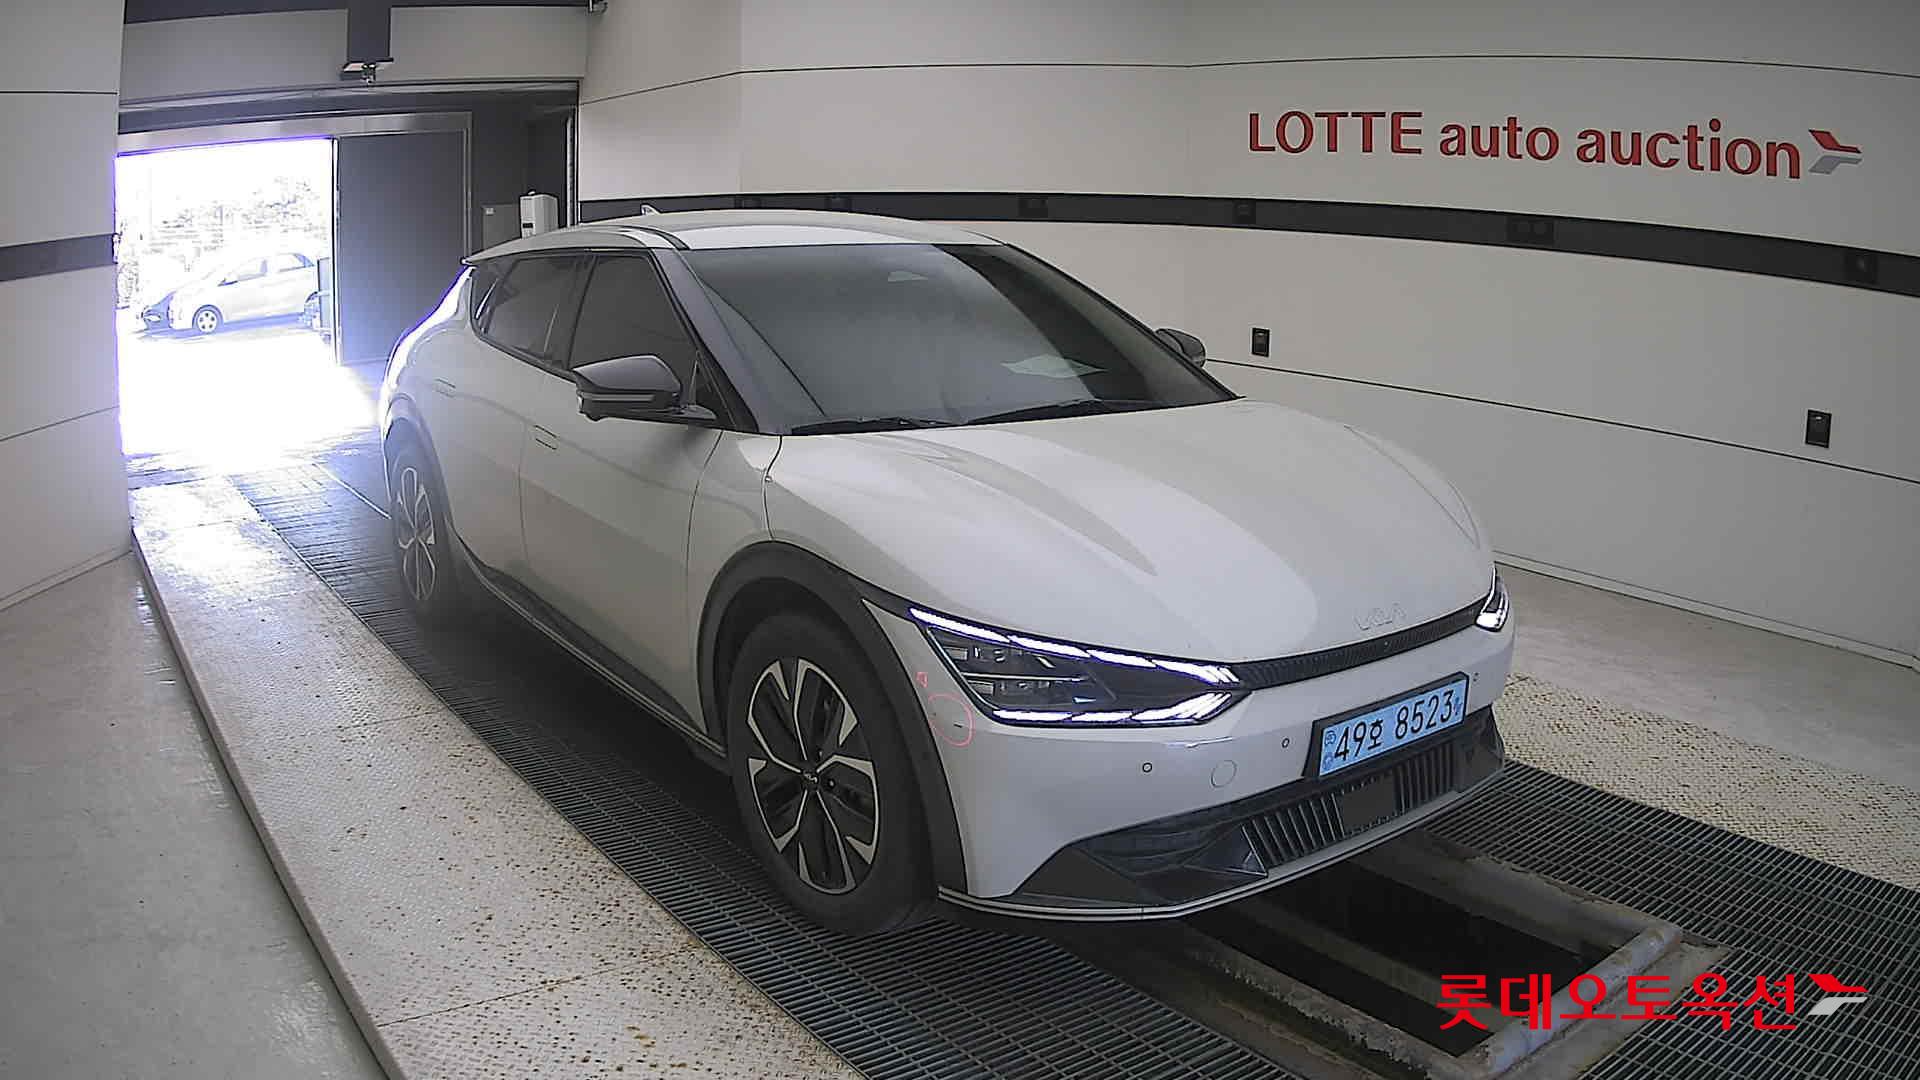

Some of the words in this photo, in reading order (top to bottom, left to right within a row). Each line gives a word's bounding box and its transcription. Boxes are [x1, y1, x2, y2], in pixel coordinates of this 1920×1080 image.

[1248, 111, 1424, 155] LOTTE
[1439, 116, 1560, 161] auto
[1576, 118, 1802, 179] auction
[1334, 718, 1384, 761] 49호
[1395, 689, 1455, 740] 8523
